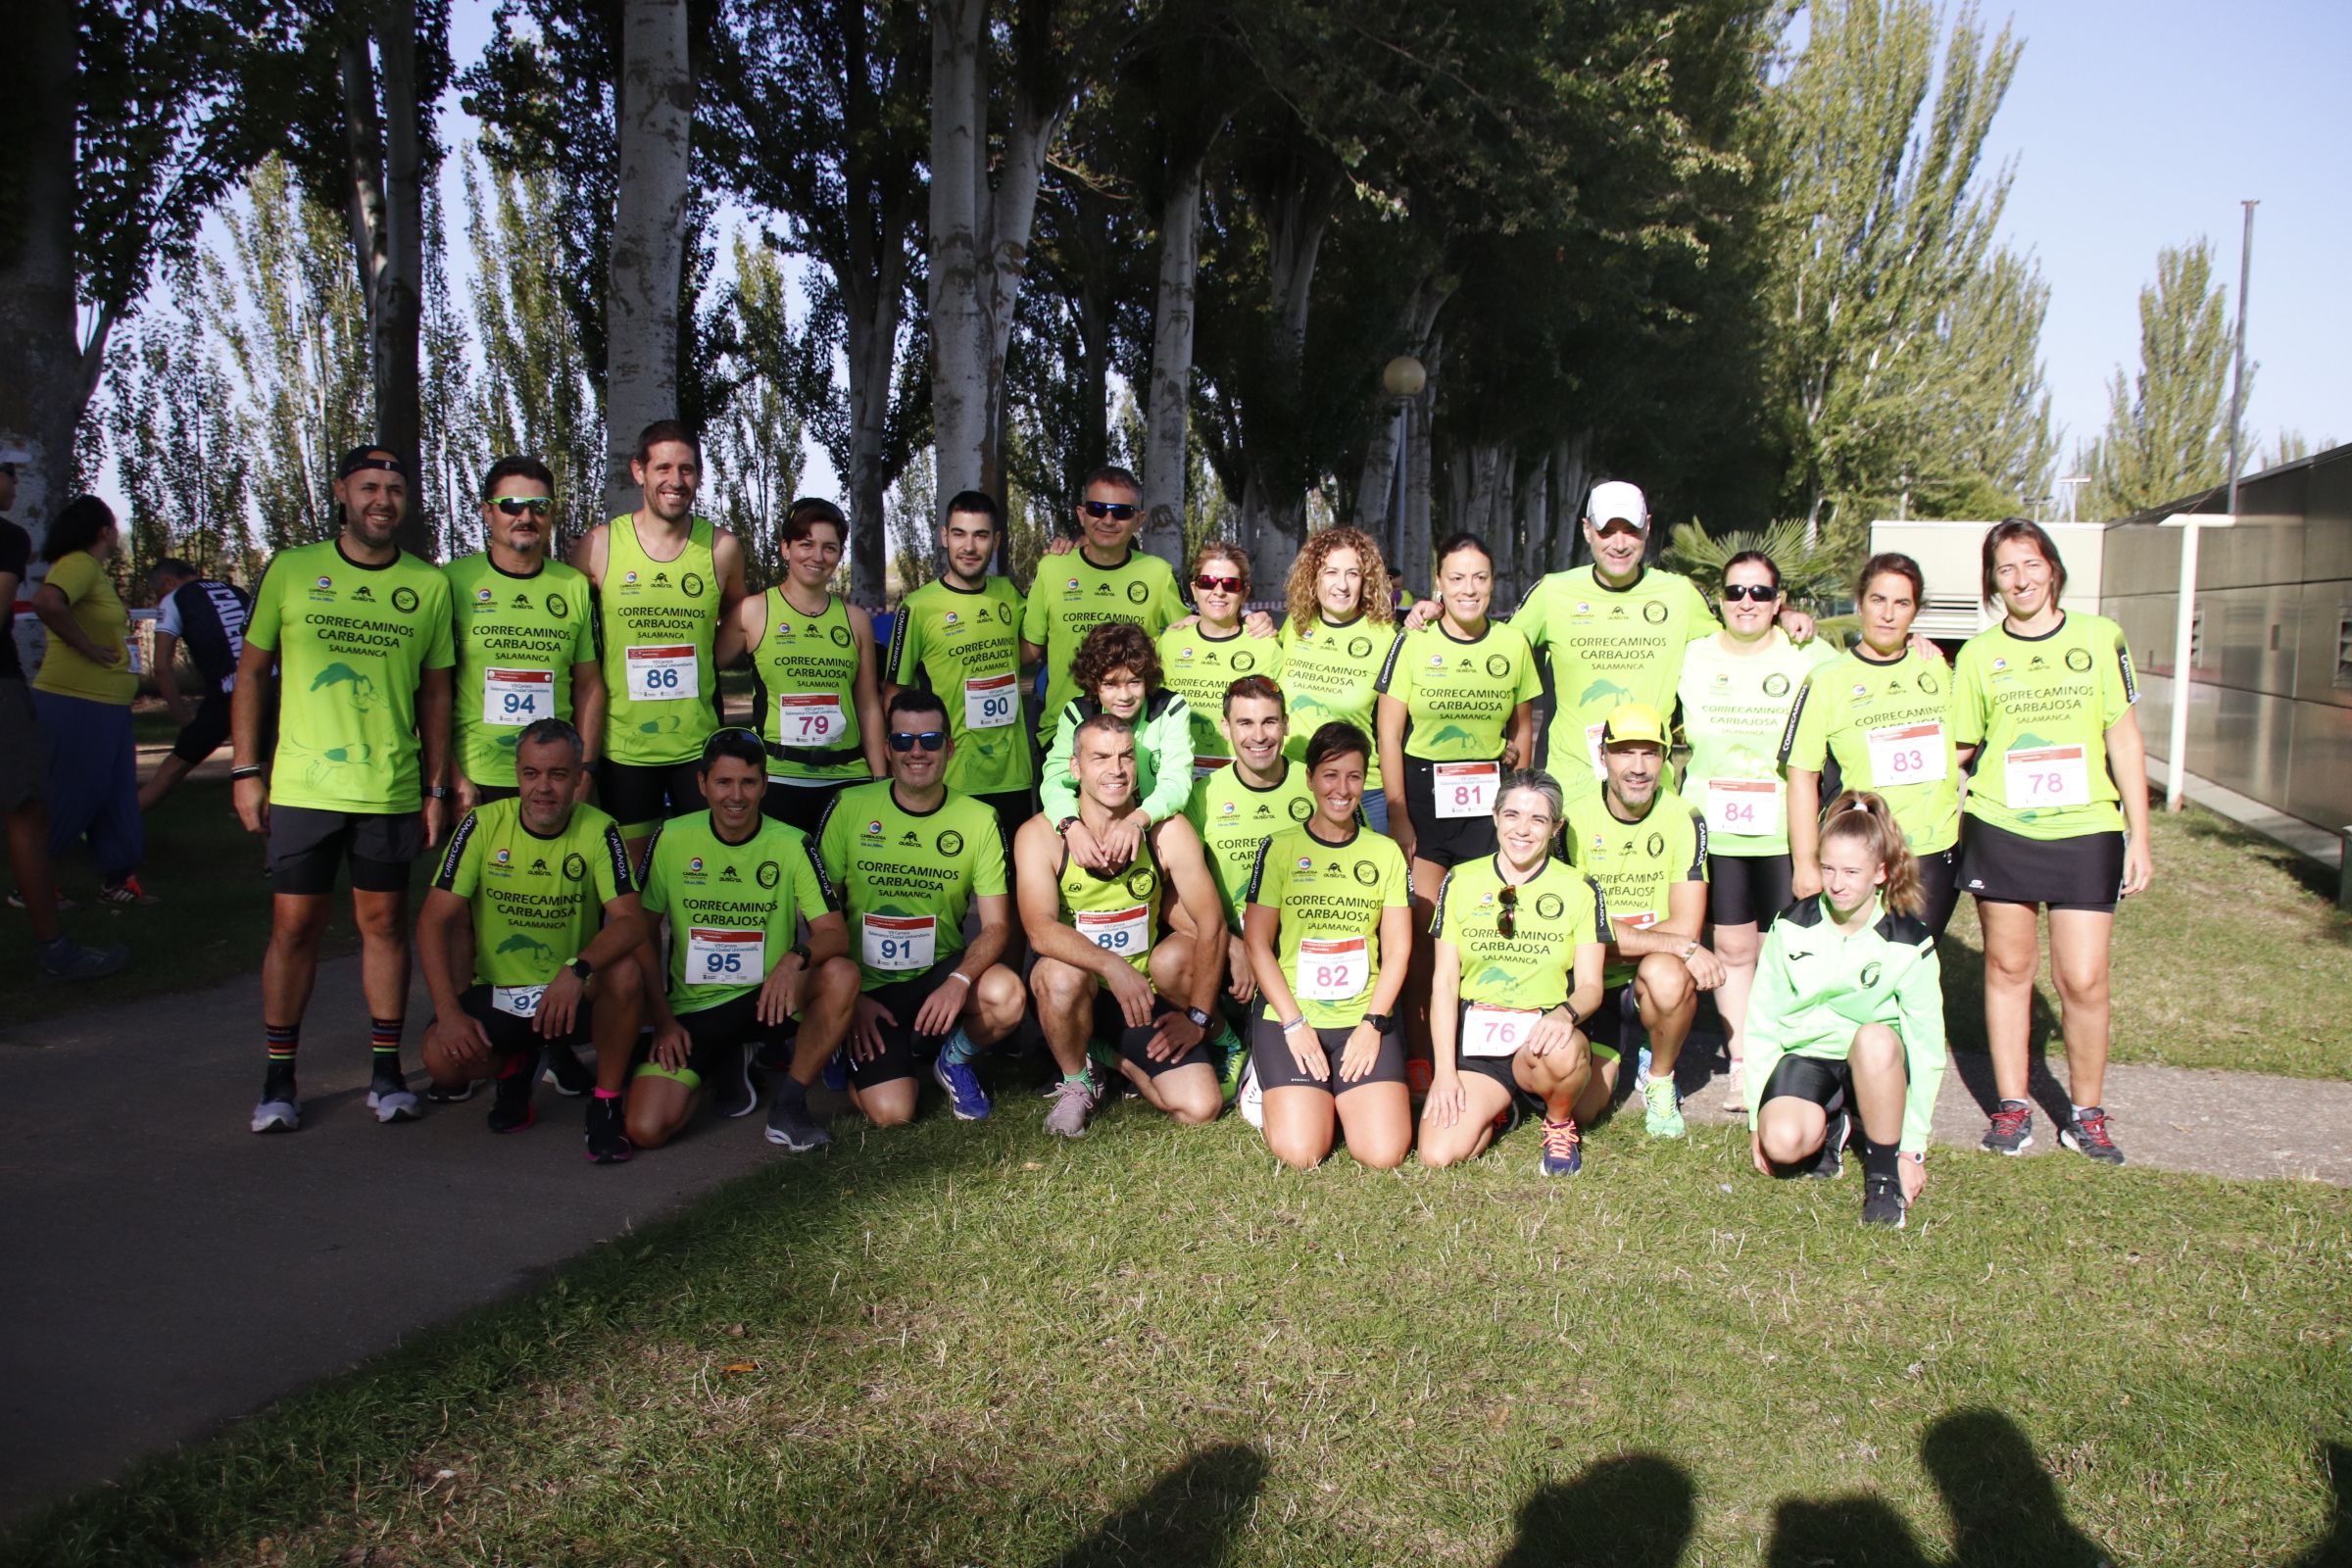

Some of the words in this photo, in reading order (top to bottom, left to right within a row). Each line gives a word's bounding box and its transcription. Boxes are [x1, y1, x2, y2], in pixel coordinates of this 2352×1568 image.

[618, 607, 705, 619] CORRECAMINOS
[1063, 612, 1145, 624] CORRECAMINOS
[306, 614, 414, 637] CORRECAMINOS
[628, 619, 693, 629] CARBAJOSA
[318, 629, 400, 648] CARBAJOSA
[473, 626, 570, 640] CORRECAMINOS
[484, 639, 561, 652] CARBAJOSA
[892, 610, 906, 671] CORRECAMINOS
[948, 637, 1015, 657] CORRECAMINO
[1570, 637, 1667, 647] CORRECAMINOS
[329, 645, 387, 657] SALAMANCA
[495, 652, 550, 662] SALAMANCA
[1382, 632, 1404, 684] CORRECAMINOS
[1581, 650, 1655, 659] CARBAJOSA
[774, 657, 854, 670] CORRECAMINOS
[1286, 658, 1368, 677] CORRECAMINOS
[647, 669, 678, 689] 86
[787, 668, 847, 679] CARBAJOSA
[1288, 670, 1354, 686] CARBAJOSA
[1170, 678, 1231, 688] CORRECAMI
[1293, 682, 1342, 694] SALAMANCA
[1176, 689, 1224, 699] ARBAJO
[1421, 688, 1511, 699] CORRECAMINOS
[1994, 686, 2093, 705] CORRECAMINOS
[504, 693, 535, 714] 94
[984, 697, 1008, 717] 90
[1429, 701, 1503, 711] CARBAJOSA
[1702, 705, 1790, 715] CORRECAMINOS
[2006, 699, 2082, 714] CARBAJOSA
[799, 716, 829, 735] 79
[1710, 717, 1778, 726] CARBAJOSA
[2016, 713, 2071, 724] SALAMANCA
[1893, 750, 1923, 771] 83
[2029, 773, 2063, 794] 78
[1455, 785, 1481, 805] 81
[1725, 803, 1754, 822] 84
[610, 832, 627, 879] CARBAJOSA
[810, 847, 832, 895] CARBAJOSA
[857, 860, 959, 880] CORRECAMINOS
[1250, 837, 1270, 893] CORRECAMINOS
[868, 876, 944, 892] CARBAJOSA
[1591, 871, 1664, 883] ORRECAMINOS
[878, 890, 931, 899] SALAMANCA
[683, 899, 777, 913] CORRECAMINOS
[1285, 896, 1380, 910] CORRECAMINOS
[497, 904, 577, 918] CARBAJOSA
[1297, 909, 1370, 922] CARBAJOSA
[508, 919, 566, 929] SALAMANCA
[693, 914, 766, 926] CARBAJOSA
[1308, 923, 1361, 933] SALAMANCA
[1462, 928, 1564, 942] CORREAMINOS
[1098, 931, 1129, 949] 89
[882, 940, 910, 959] 91
[1471, 941, 1550, 955] CARBAJOSA
[707, 953, 741, 972] 95
[1483, 955, 1538, 965] SALAMANCA
[1317, 966, 1349, 987] 82
[514, 991, 543, 1010] 92
[1485, 1023, 1515, 1042] 76
